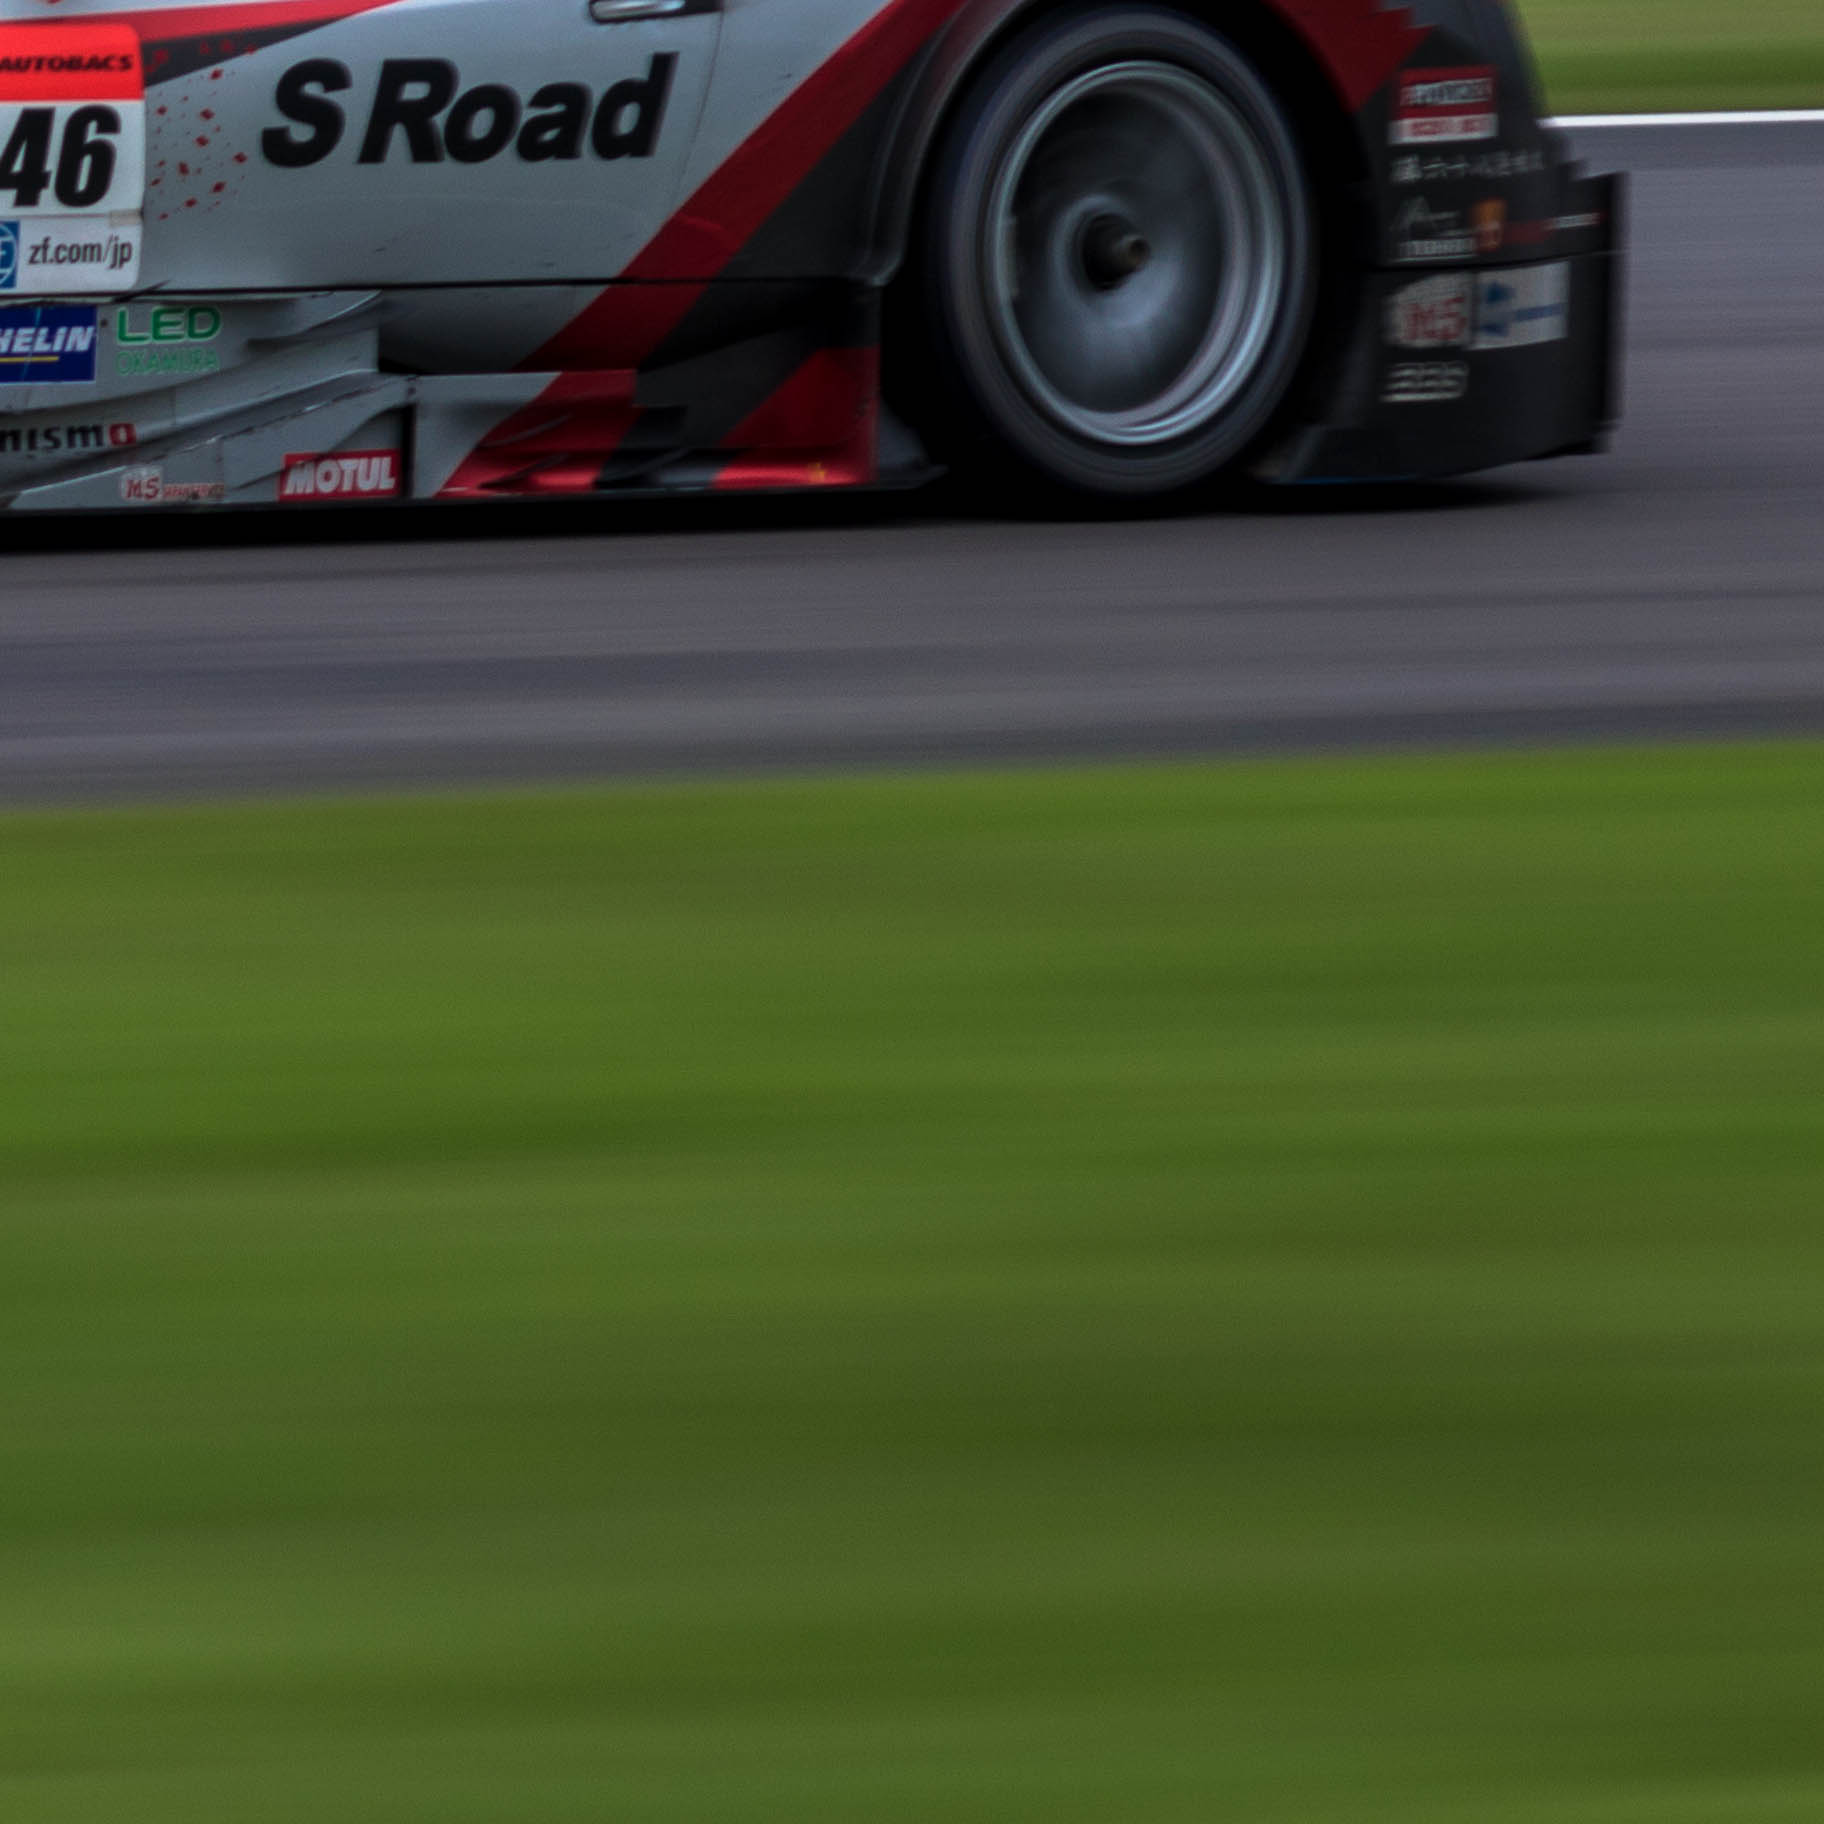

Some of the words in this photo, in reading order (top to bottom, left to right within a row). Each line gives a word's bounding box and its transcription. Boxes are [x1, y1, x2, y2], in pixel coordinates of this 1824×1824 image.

[260, 57, 354, 170] S
[356, 51, 681, 165] Road
[28, 236, 134, 269] zf.com/jp
[116, 307, 222, 345] LED
[117, 348, 222, 375] OKAMURA
[283, 457, 396, 496] MOTUL
